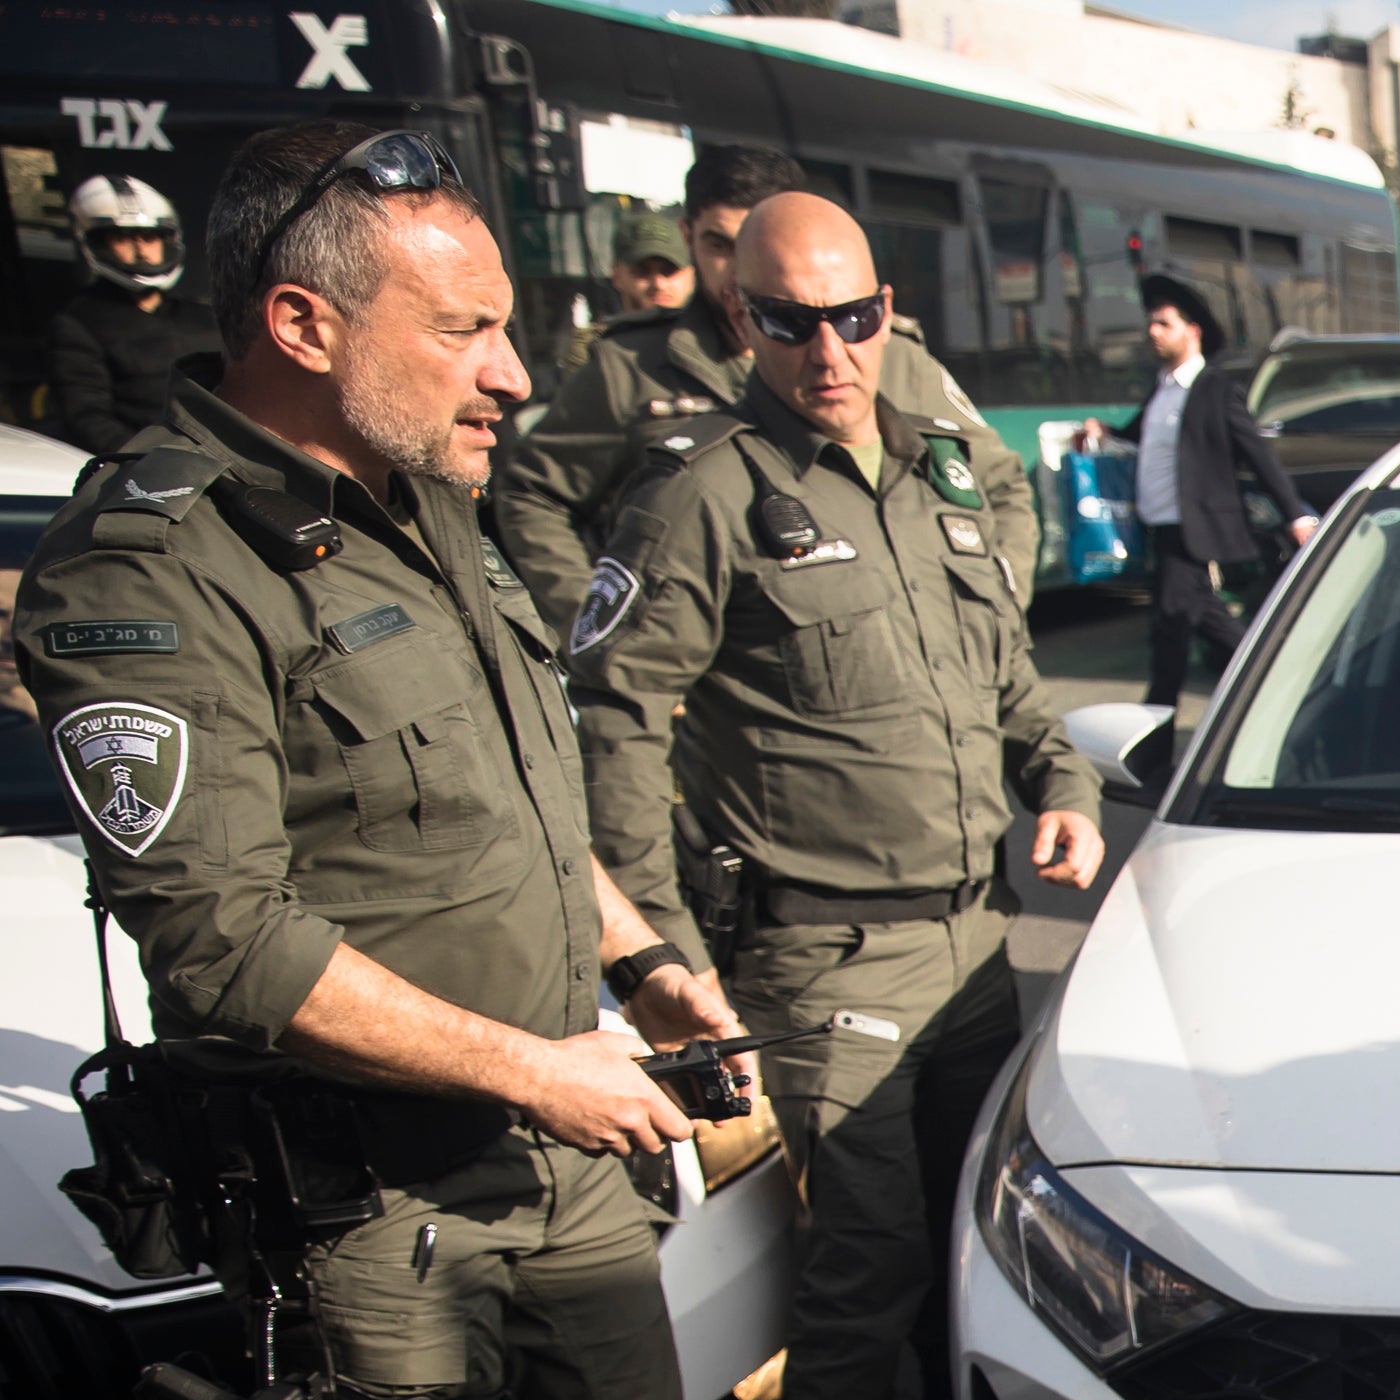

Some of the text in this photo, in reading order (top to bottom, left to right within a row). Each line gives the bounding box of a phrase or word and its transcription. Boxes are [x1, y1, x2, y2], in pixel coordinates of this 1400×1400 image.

[60, 96, 175, 152] אגד
[61, 715, 173, 745] משטרת ישראל
